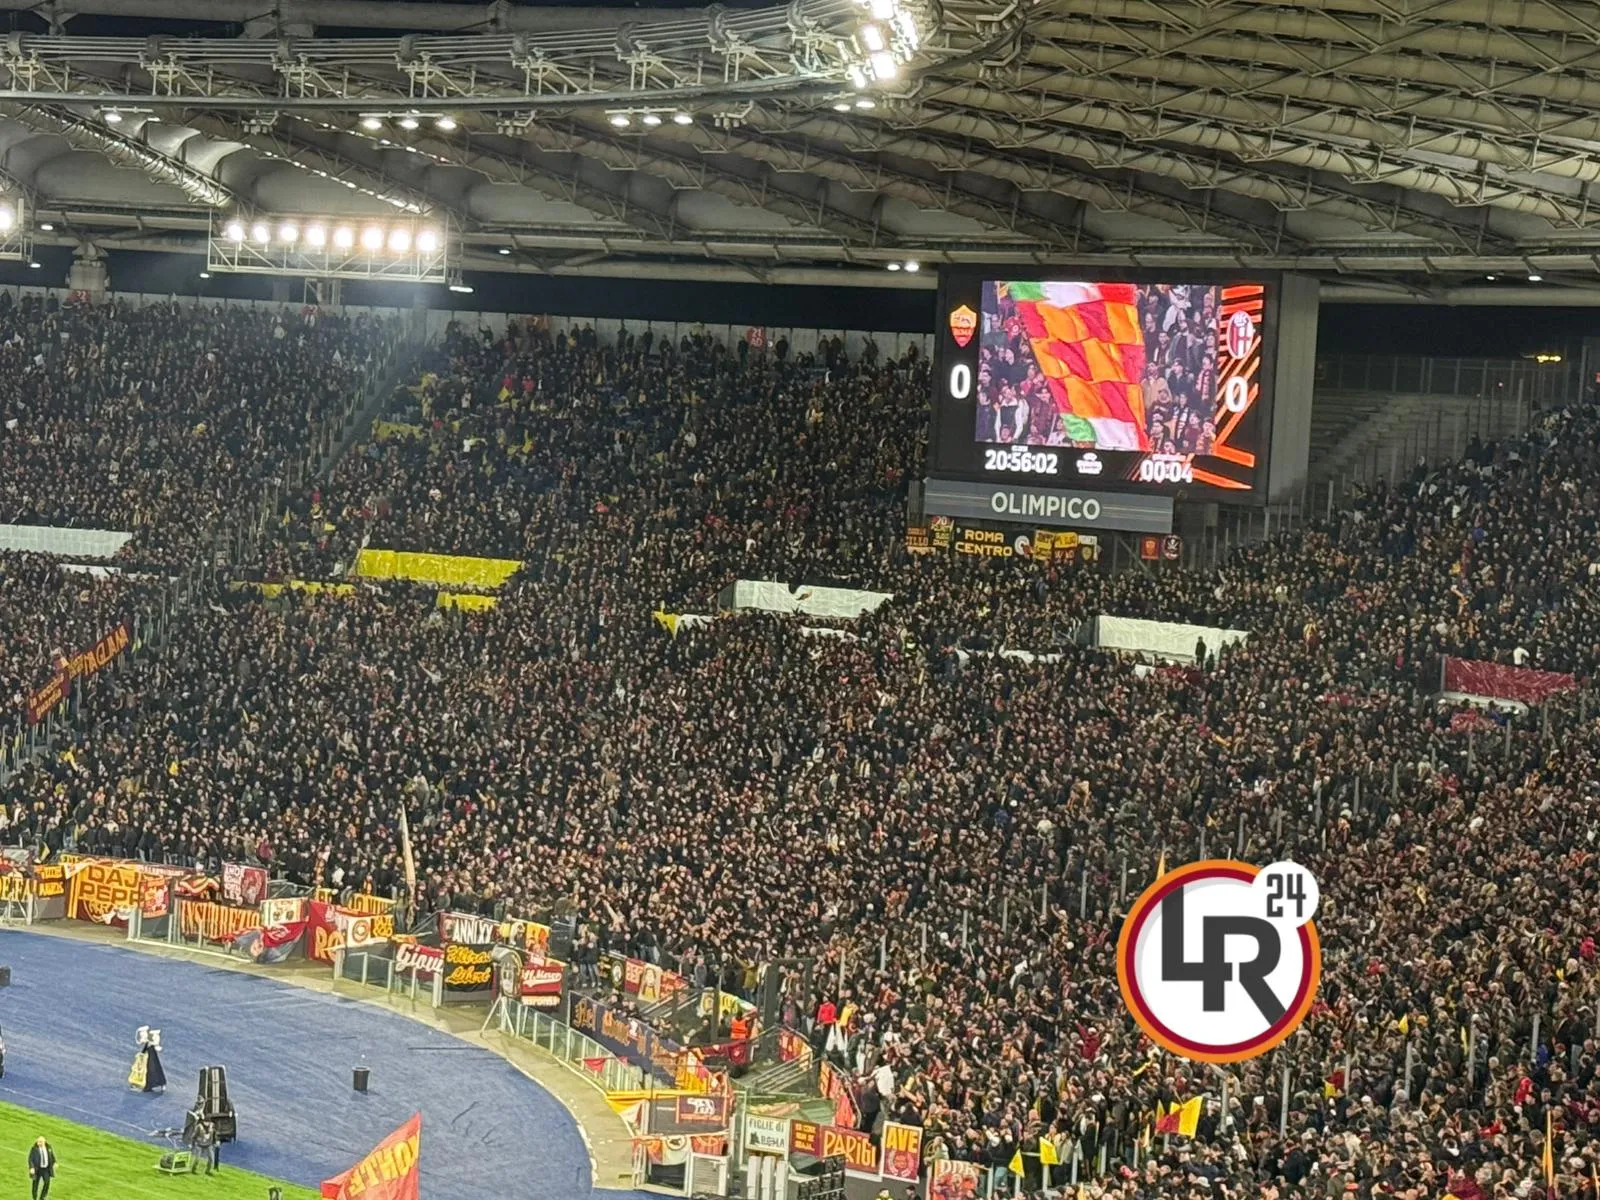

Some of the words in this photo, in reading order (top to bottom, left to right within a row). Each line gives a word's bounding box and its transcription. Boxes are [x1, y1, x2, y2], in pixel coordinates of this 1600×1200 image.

[950, 364, 971, 400] 0
[1225, 376, 1248, 413] 0
[984, 449, 1059, 475] 20:56:02
[1140, 459, 1193, 484] 00:04
[991, 491, 1101, 521] OLIMPICO
[965, 528, 1005, 543] ROMA
[955, 541, 1013, 557] CENTRO
[749, 1118, 774, 1131] FIGLIE
[886, 1127, 918, 1154] AVE
